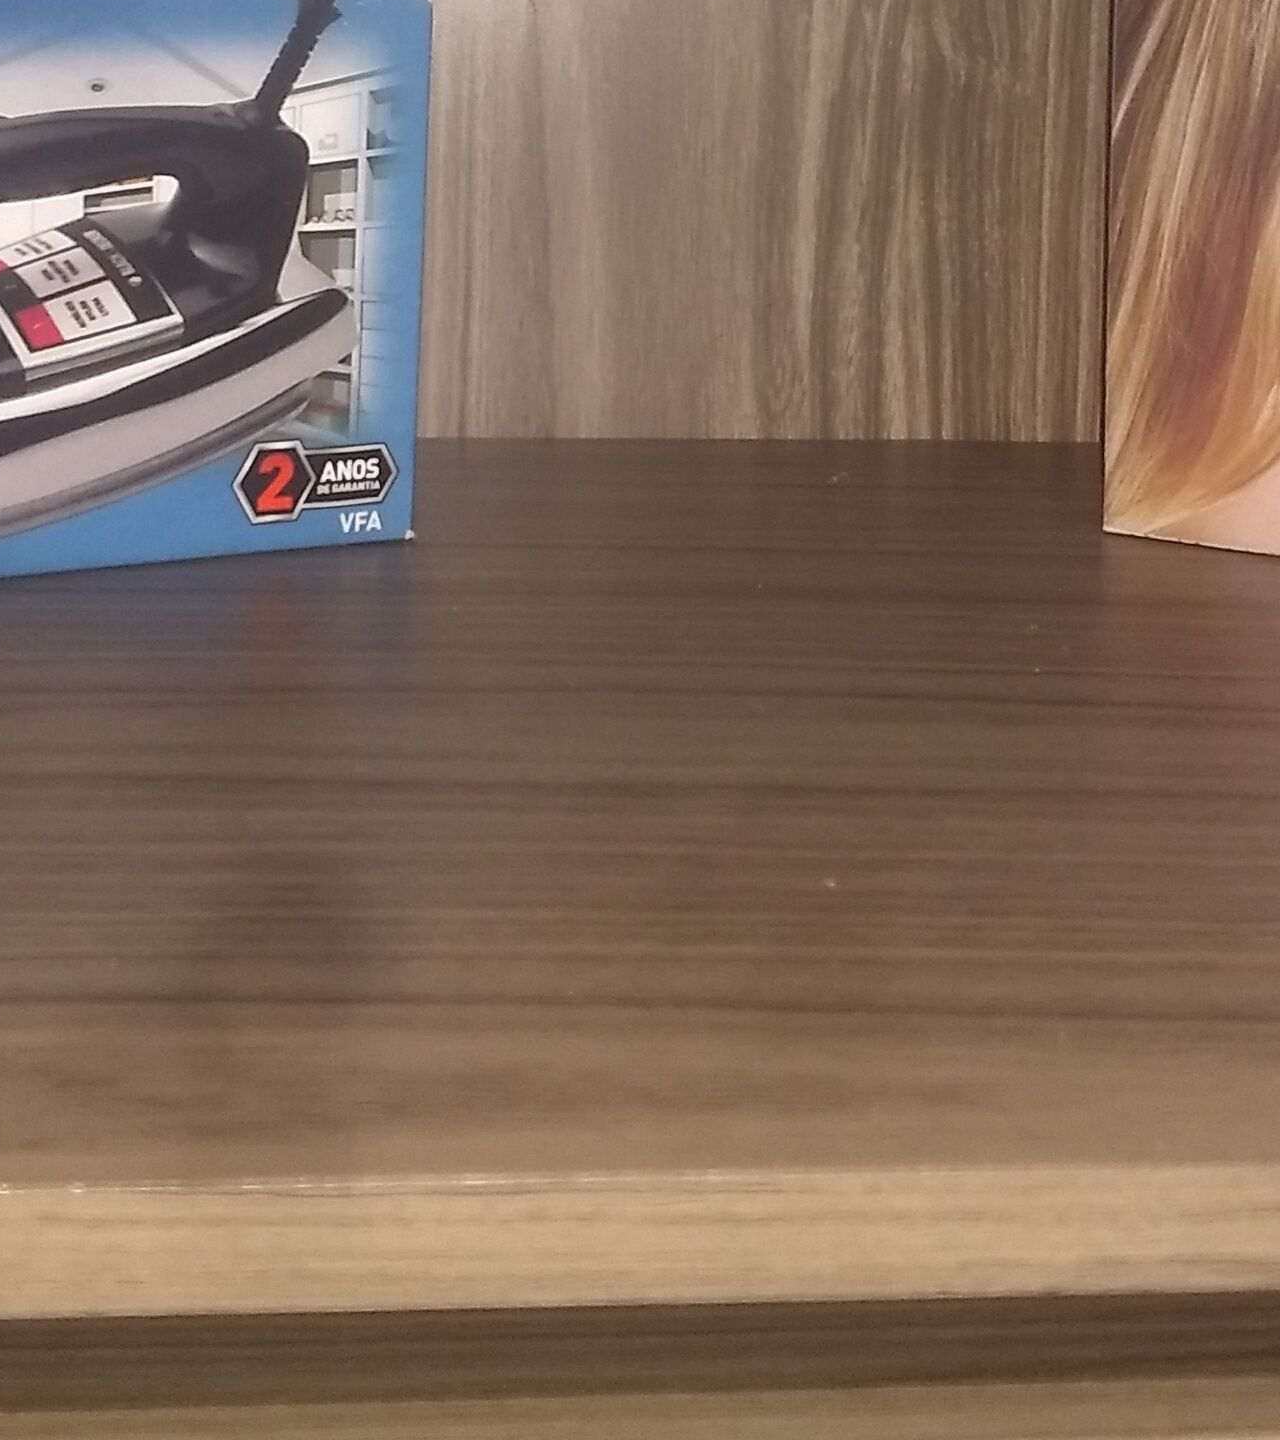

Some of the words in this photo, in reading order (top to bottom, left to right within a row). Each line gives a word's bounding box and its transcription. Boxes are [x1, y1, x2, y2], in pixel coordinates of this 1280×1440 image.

[255, 452, 296, 513] 2
[319, 457, 380, 483] ANOS
[339, 510, 382, 534] VFA
